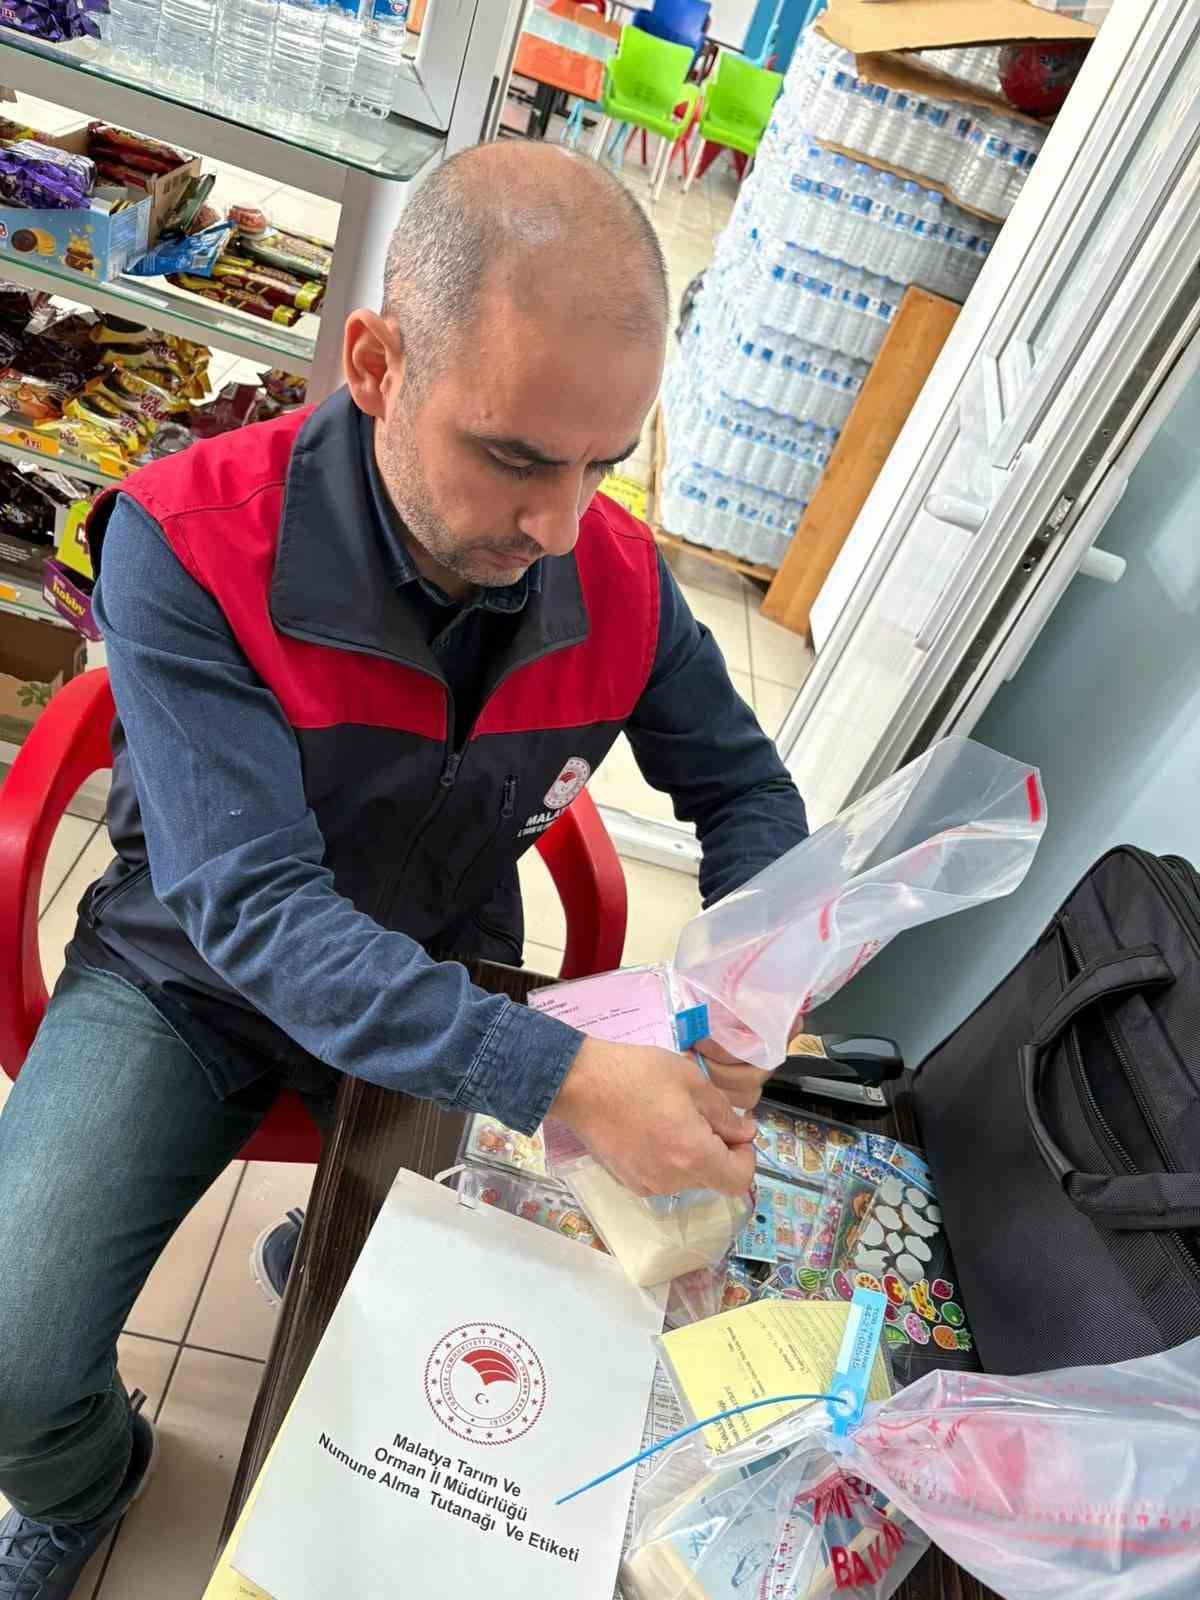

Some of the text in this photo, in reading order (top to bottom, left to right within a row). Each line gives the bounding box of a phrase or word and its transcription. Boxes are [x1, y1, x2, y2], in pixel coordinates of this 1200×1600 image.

[52, 581, 86, 616] hobby
[318, 1432, 580, 1562] Numune Alma Tutanağı Ve Etiketi
[375, 1447, 528, 1522] Orman İl Müdürlüğü
[393, 1433, 521, 1497] Malatya Tarım Ve
